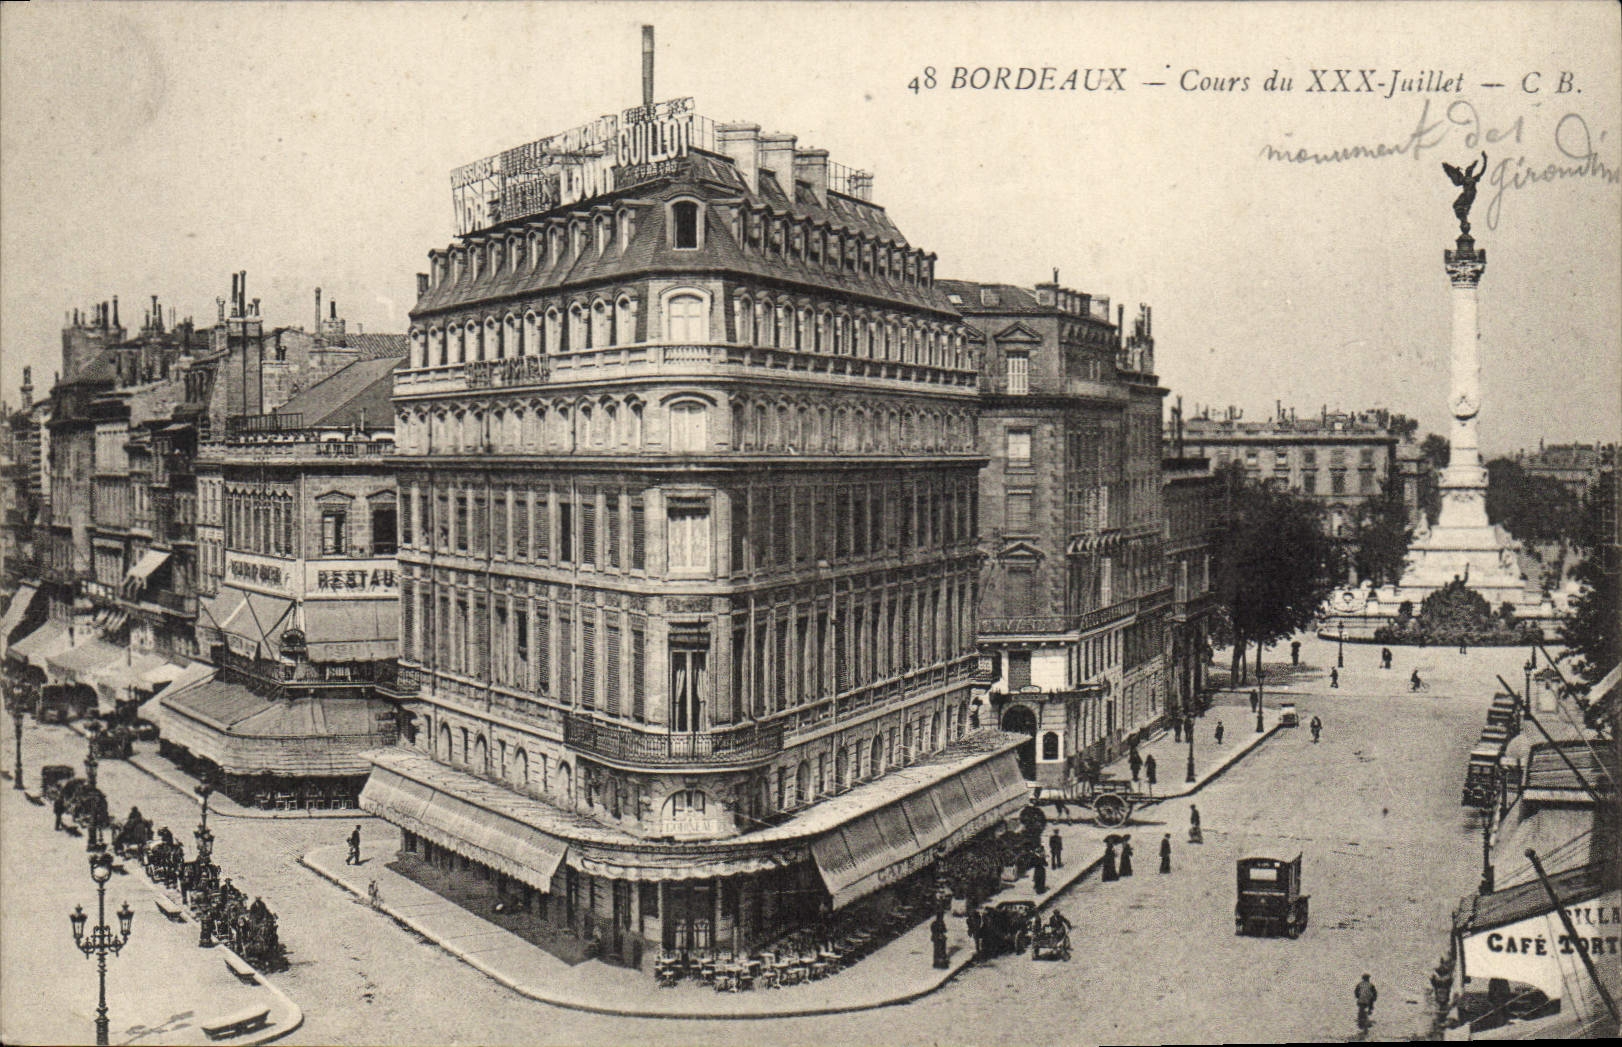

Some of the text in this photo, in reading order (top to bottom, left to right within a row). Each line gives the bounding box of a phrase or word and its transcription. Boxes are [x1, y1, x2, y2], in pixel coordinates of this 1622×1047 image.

[617, 113, 692, 168] GUILLOT
[318, 568, 399, 592] RESTAU
[1486, 932, 1548, 956] CAFÉ
